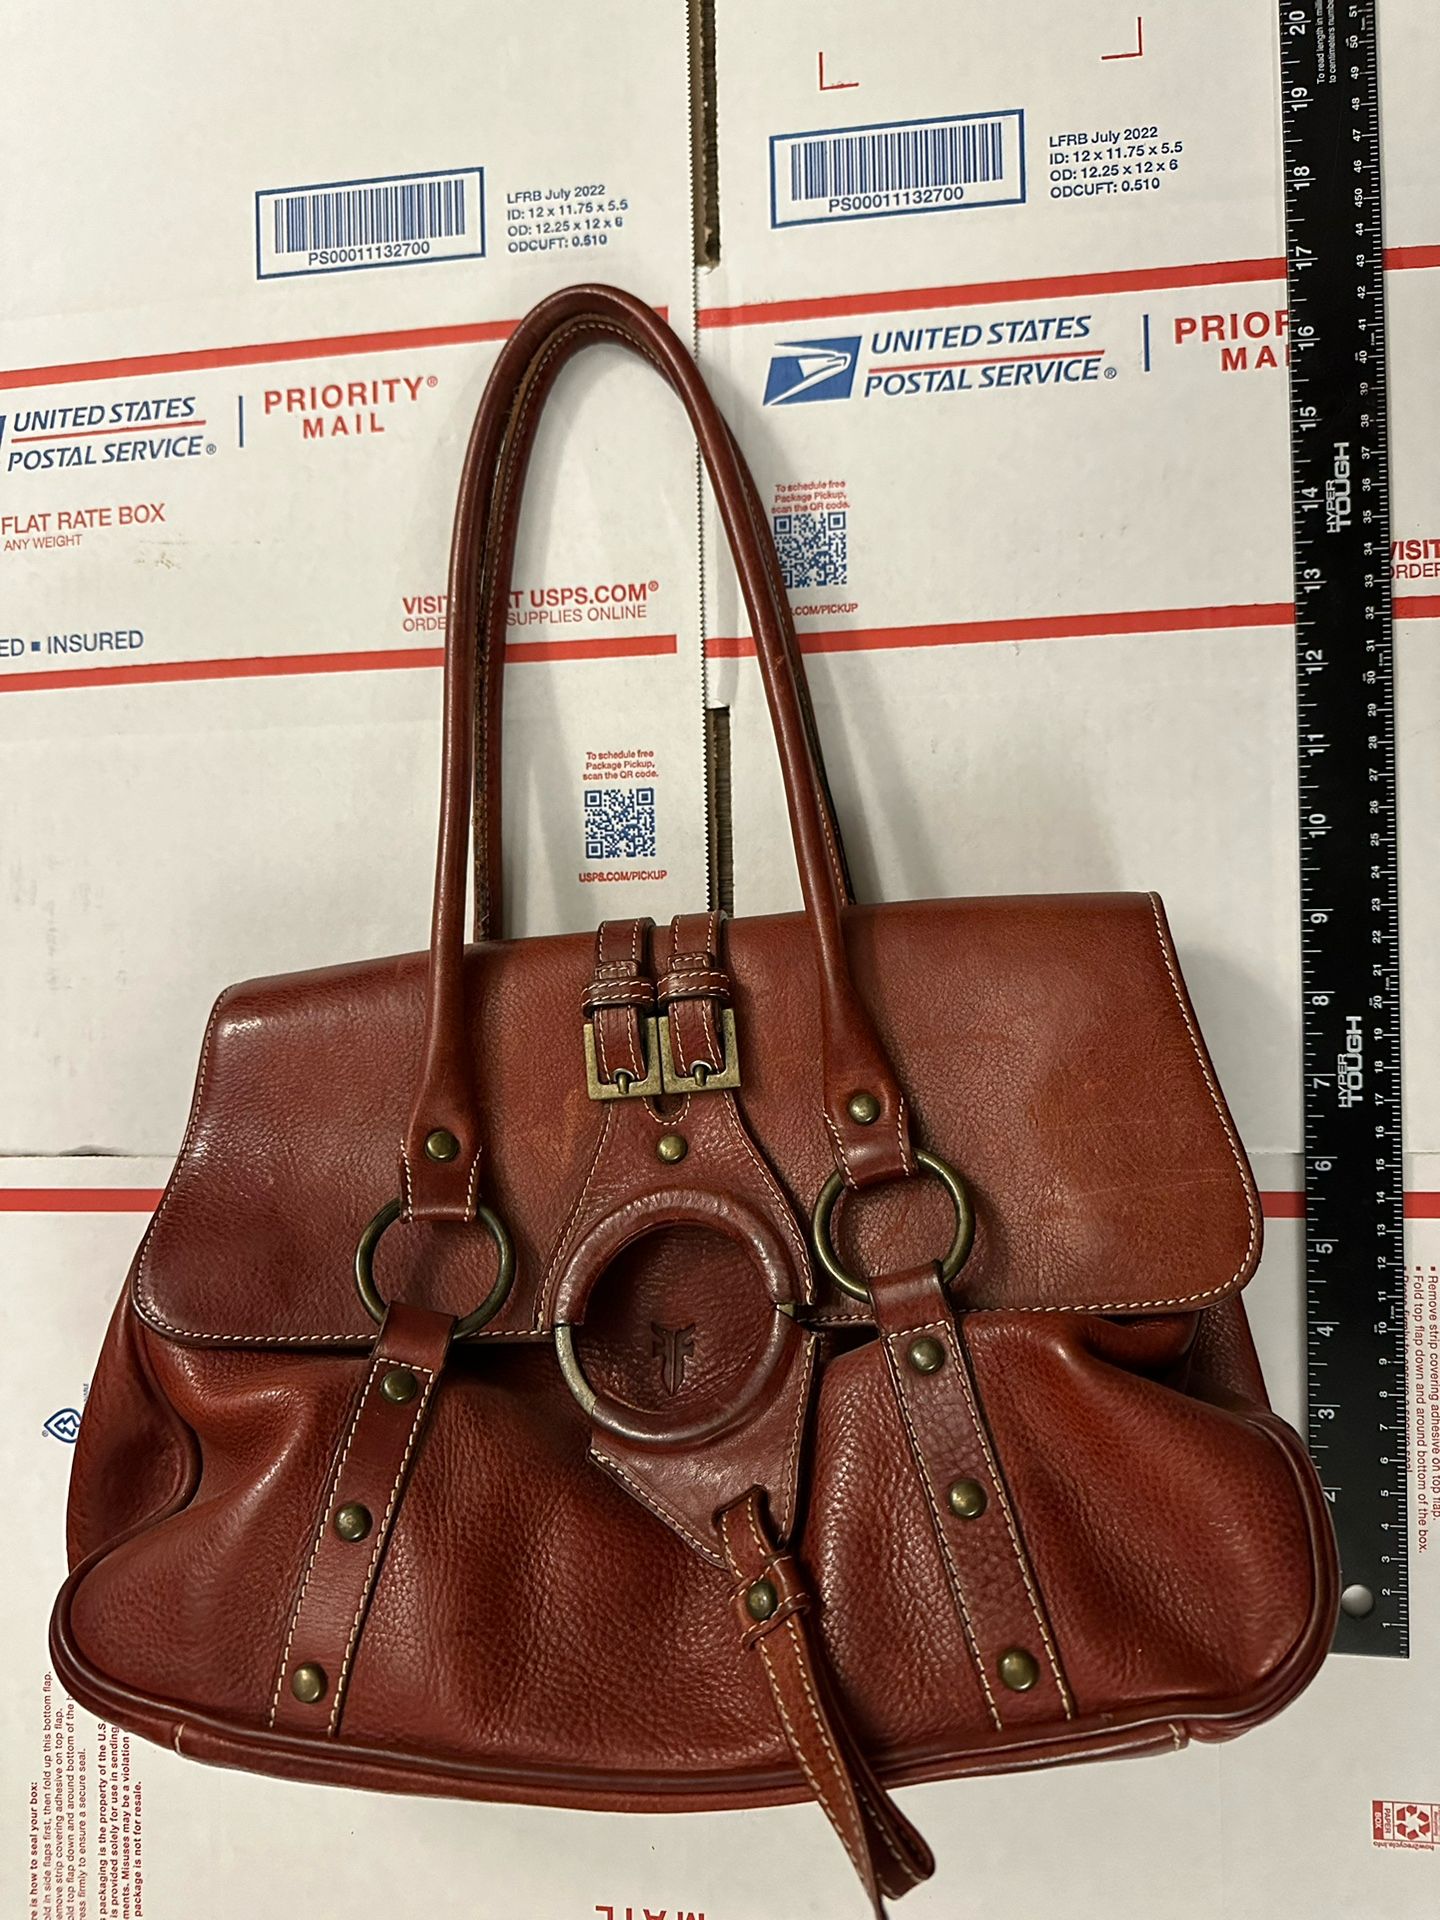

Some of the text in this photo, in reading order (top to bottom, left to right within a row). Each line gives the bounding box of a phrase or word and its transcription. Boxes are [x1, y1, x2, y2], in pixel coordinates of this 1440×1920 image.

[1289, 10, 1306, 35] 20
[1350, 36, 1358, 48] 50
[1291, 87, 1308, 111] 19
[1050, 127, 1158, 147] LFRB July 2022
[1050, 153, 1068, 164] ID:
[1073, 151, 1090, 162] 12
[1107, 145, 1145, 159] 11.75
[1149, 147, 1157, 155] x
[1161, 142, 1183, 154] 5.5
[1050, 159, 1178, 181] OD: 12.25 x 12 x 6
[1293, 166, 1310, 190] 18
[507, 184, 605, 204] LFRB July 2022
[1051, 178, 1159, 198] ODCUFT: 0.510
[1354, 188, 1363, 208] 450
[507, 199, 628, 220] ID: 12 x 11.75 x 5.5
[829, 187, 964, 213] PS00011132700
[508, 225, 532, 236] OD:
[536, 221, 570, 234] 12.25
[574, 222, 581, 230] x
[585, 218, 600, 229] 12
[604, 220, 611, 228] x
[309, 241, 430, 266] PS00011132700
[508, 234, 607, 252] ODCUFT: 0.510
[1296, 246, 1312, 270] 17
[871, 315, 1091, 354] UNITED STATES
[1298, 325, 1314, 350] 16
[1359, 351, 1367, 364] 40
[865, 369, 972, 397] POSTAL
[14, 397, 195, 432] UNITED STATES
[1300, 406, 1317, 431] 15
[303, 413, 384, 439] MAIL
[8, 446, 97, 471] POSTAL
[1326, 442, 1351, 533] HYPER TOUGH
[1302, 487, 1318, 512] 14
[1, 503, 165, 535] FLAT RATE BOX
[1363, 510, 1372, 523] 35
[4, 535, 82, 551] ANY WEIGHT
[1304, 568, 1321, 593] 13
[507, 608, 582, 626] SUPPLIES
[587, 605, 647, 620] ONLINE
[48, 630, 143, 654] INSURED
[1306, 649, 1322, 674] 12
[1367, 671, 1376, 684] 30
[586, 750, 654, 760] To schedule free
[1307, 735, 1324, 756] 11
[586, 760, 655, 770] Package Pickup,
[620, 771, 633, 779] QR
[635, 770, 658, 778] code.
[1309, 813, 1326, 837] 10
[1370, 833, 1379, 846] 25
[579, 870, 667, 882] USPS.COM/PICKUP
[1310, 913, 1328, 923] 9
[1312, 996, 1329, 1006] 8
[1373, 996, 1382, 1008] 20
[1338, 1016, 1363, 1108] HYPER TOUGH
[1313, 1078, 1330, 1088] 7
[1315, 1160, 1332, 1171] 6
[1376, 1158, 1385, 1171] 15
[1316, 1243, 1333, 1254] 5
[1428, 1275, 1438, 1321] Remove
[1317, 1326, 1334, 1337] 4
[1378, 1322, 1387, 1335] 10
[1428, 1324, 1439, 1349] strip
[1429, 1353, 1440, 1400] covering
[1318, 1409, 1335, 1419] 3
[1412, 1275, 1428, 1553] Fold top flap down and around bottom of the box.
[1431, 1404, 1440, 1453] adhesive
[1432, 1458, 1440, 1471] on
[1430, 1475, 1440, 1493] top
[54, 1708, 64, 1729] flap.
[55, 1733, 64, 1749] top
[55, 1753, 63, 1764] on
[98, 1745, 106, 1761] the
[98, 1765, 106, 1775] of
[30, 1782, 38, 1804] box:
[54, 1768, 63, 1812] adhesive
[133, 1782, 141, 1817] resale.
[99, 1779, 108, 1823] property
[31, 1807, 39, 1831] your
[133, 1820, 141, 1835] for
[30, 1834, 38, 1855] seal
[54, 1815, 64, 1858] covering
[98, 1827, 106, 1843] the
[98, 1847, 106, 1855] is
[30, 1859, 38, 1869] to
[54, 1860, 64, 1884] strip
[133, 1860, 141, 1868] is
[30, 1873, 38, 1895] how
[98, 1859, 108, 1915] packaging
[133, 1871, 143, 1917] package
[30, 1897, 38, 1907] is
